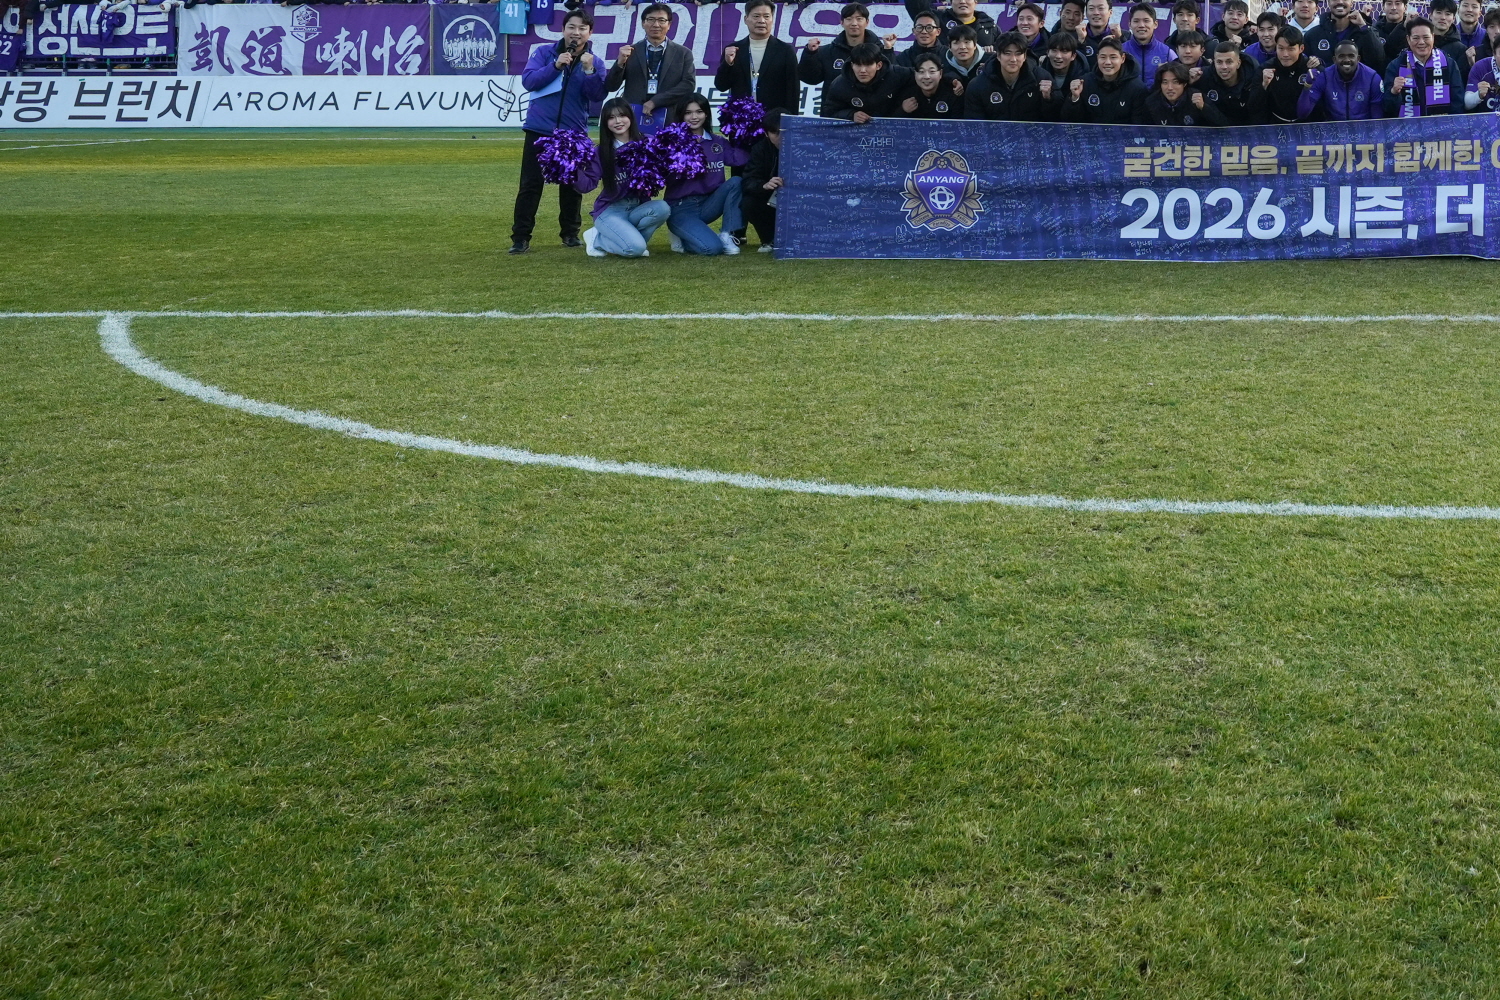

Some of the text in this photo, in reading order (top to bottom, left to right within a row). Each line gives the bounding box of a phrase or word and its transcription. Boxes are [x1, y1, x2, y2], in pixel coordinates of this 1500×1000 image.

[38, 5, 168, 56] 정신으로
[504, 3, 519, 18] 41
[1433, 48, 1442, 100] THE BOYS
[68, 80, 202, 122] 브런치
[213, 91, 483, 111] A'ROMA FLAVUM
[1124, 145, 1210, 177] 굳건한
[1221, 145, 1288, 175] 믿음,
[1296, 143, 1384, 173] 끝까지
[1393, 139, 1484, 173] 함께한
[918, 176, 965, 184] ANYANG
[1119, 187, 1286, 240] 2026
[1301, 185, 1418, 240] 시즌,
[1435, 183, 1485, 236] 더
